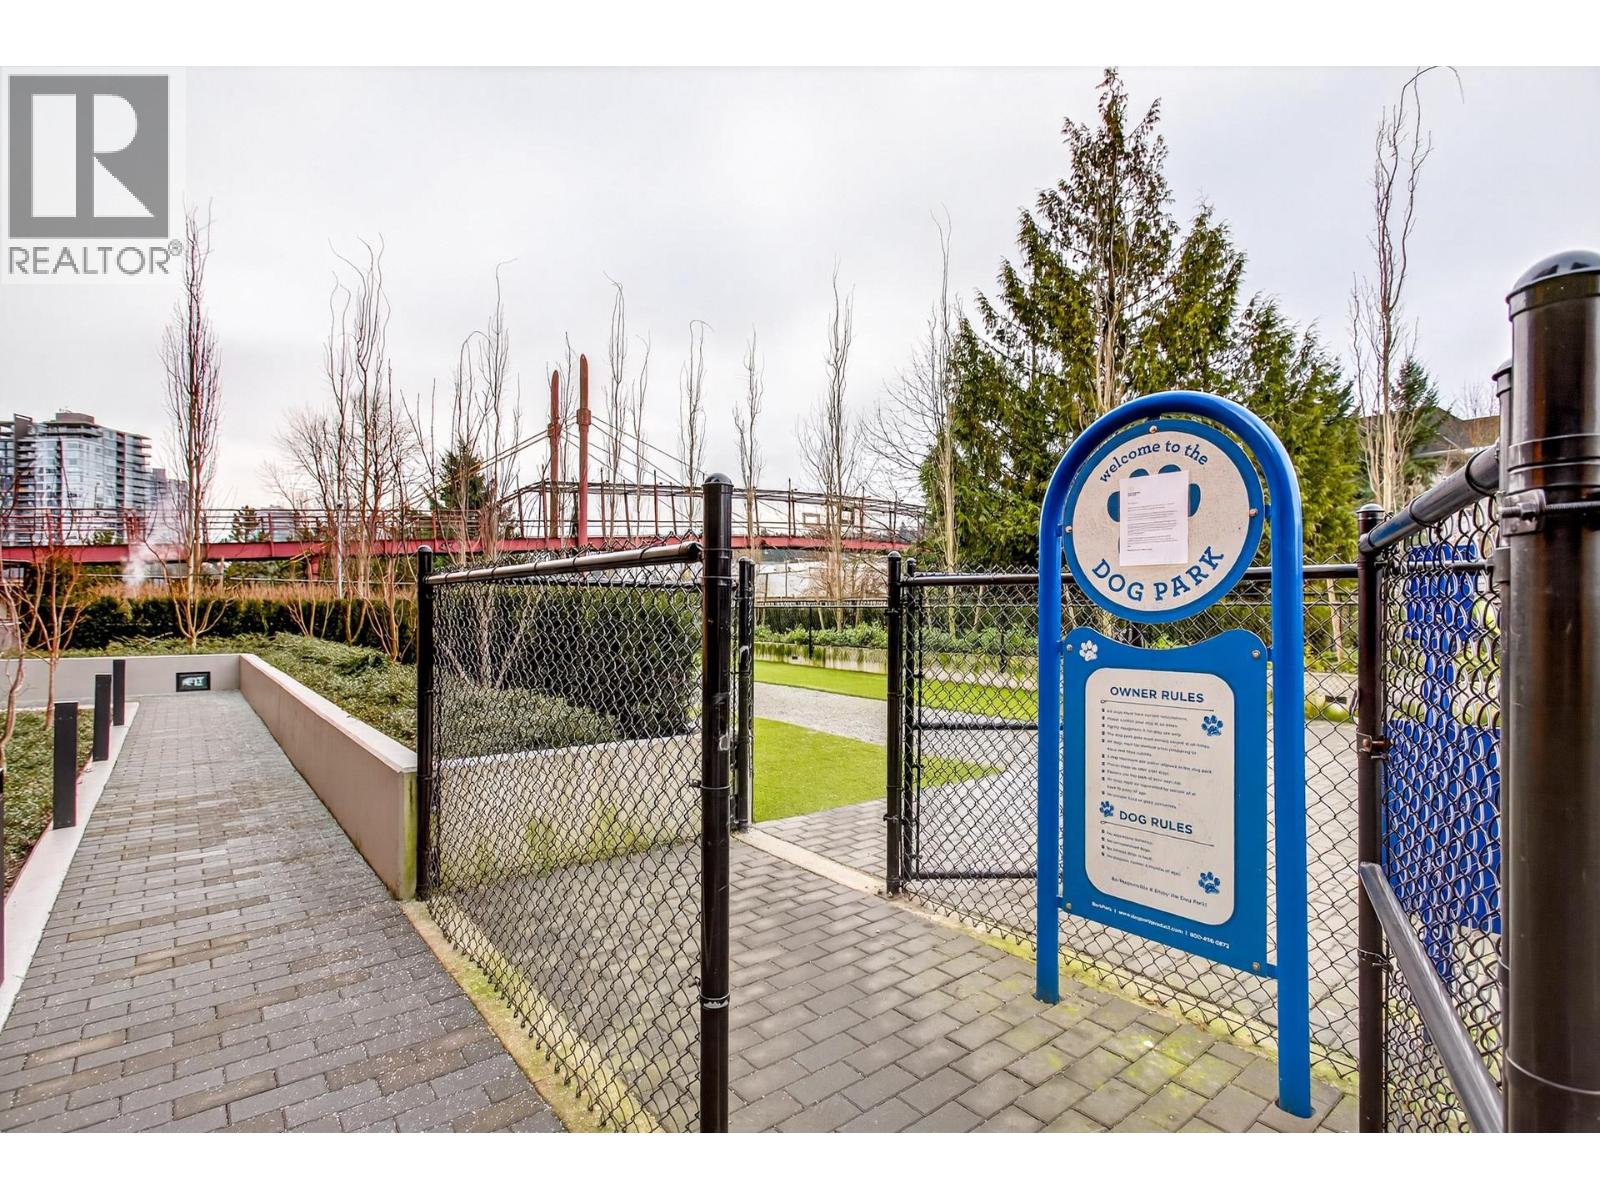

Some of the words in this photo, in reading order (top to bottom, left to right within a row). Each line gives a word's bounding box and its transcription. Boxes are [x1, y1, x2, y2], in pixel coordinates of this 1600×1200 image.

[1100, 441, 1160, 483] welcome
[1165, 440, 1181, 453] to
[1184, 443, 1208, 465] the
[1092, 558, 1145, 601] DOG
[1153, 546, 1224, 601] PARK
[1110, 686, 1157, 699] OWNER
[1161, 690, 1205, 703] RULES
[1119, 810, 1147, 824] DOG
[1151, 817, 1193, 834] RULES
